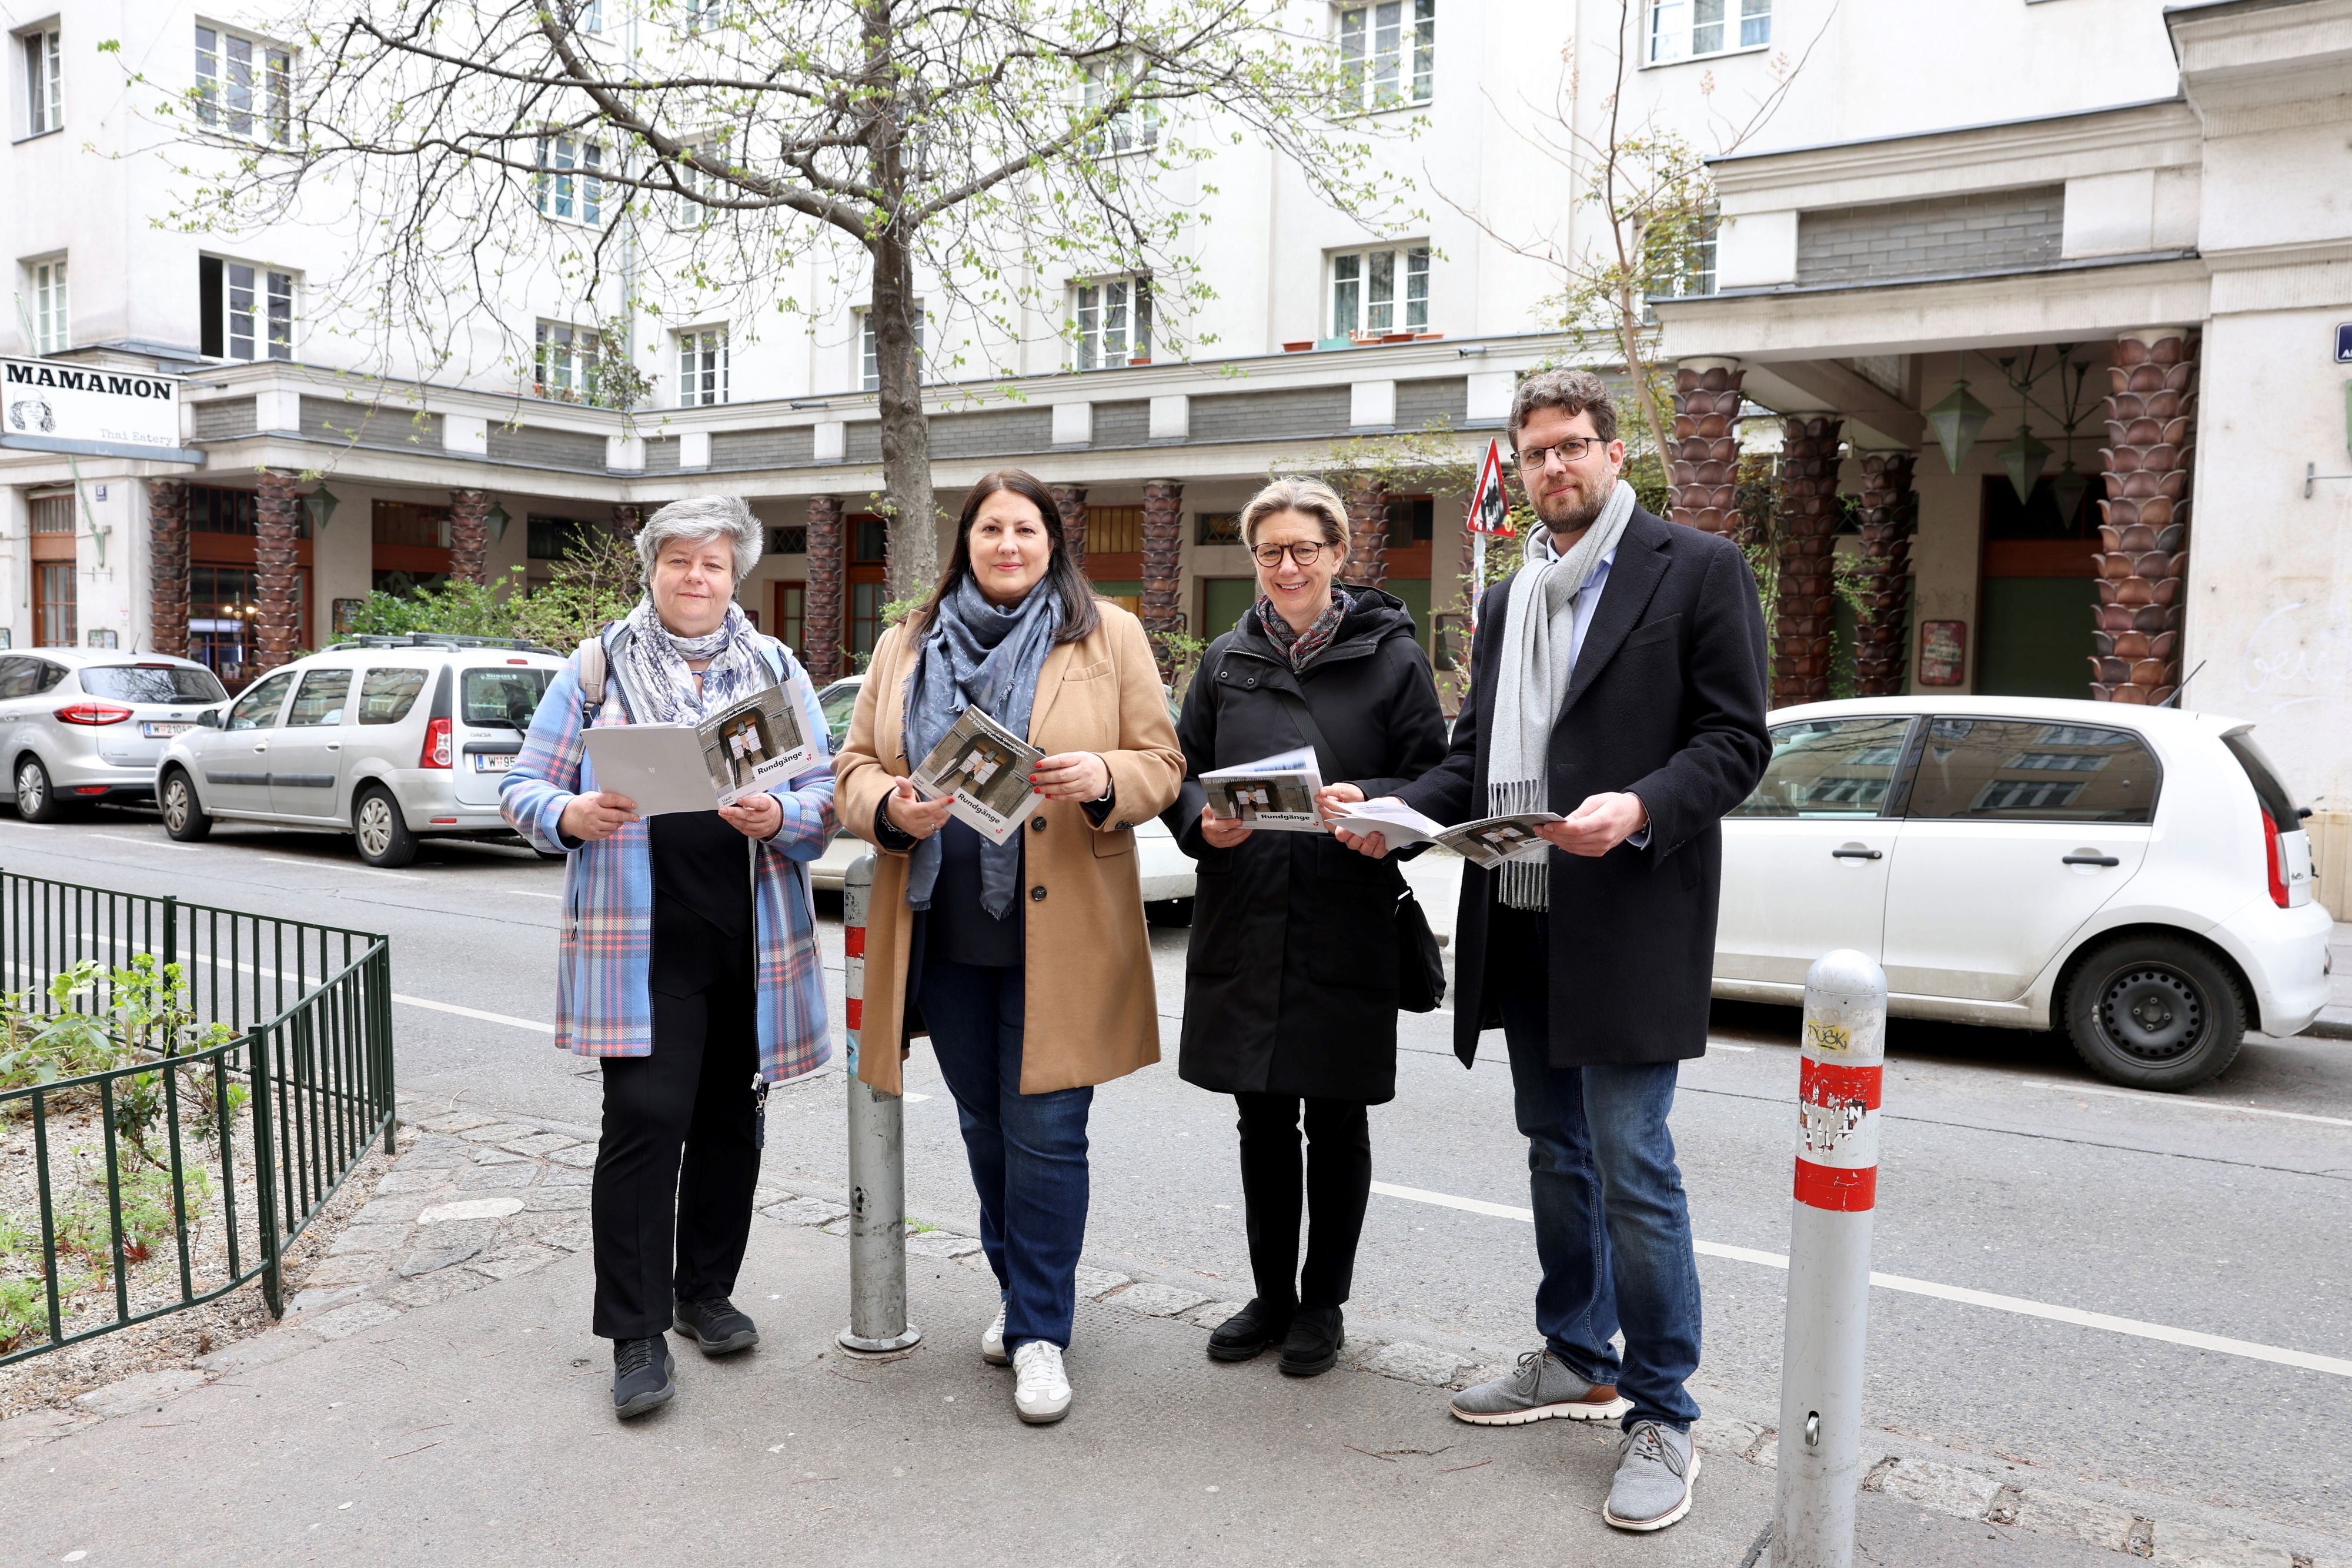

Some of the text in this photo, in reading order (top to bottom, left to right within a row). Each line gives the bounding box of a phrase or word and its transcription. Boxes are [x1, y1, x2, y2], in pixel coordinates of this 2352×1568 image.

[6, 364, 171, 400] MAMAMON
[99, 428, 173, 446] Thai Eatery
[722, 702, 761, 723] Nationalsozialismus
[734, 697, 762, 711] Gemeindebau
[153, 724, 159, 733] W
[972, 720, 980, 728] Zeit
[987, 731, 1024, 758] Nationalsozialismus
[1003, 737, 1030, 755] Gemeindebau
[489, 757, 496, 767] W
[757, 750, 803, 775] Rundgänge
[913, 779, 922, 788] Wien
[914, 775, 924, 785] Stadt
[957, 793, 1000, 824] Rundgänge
